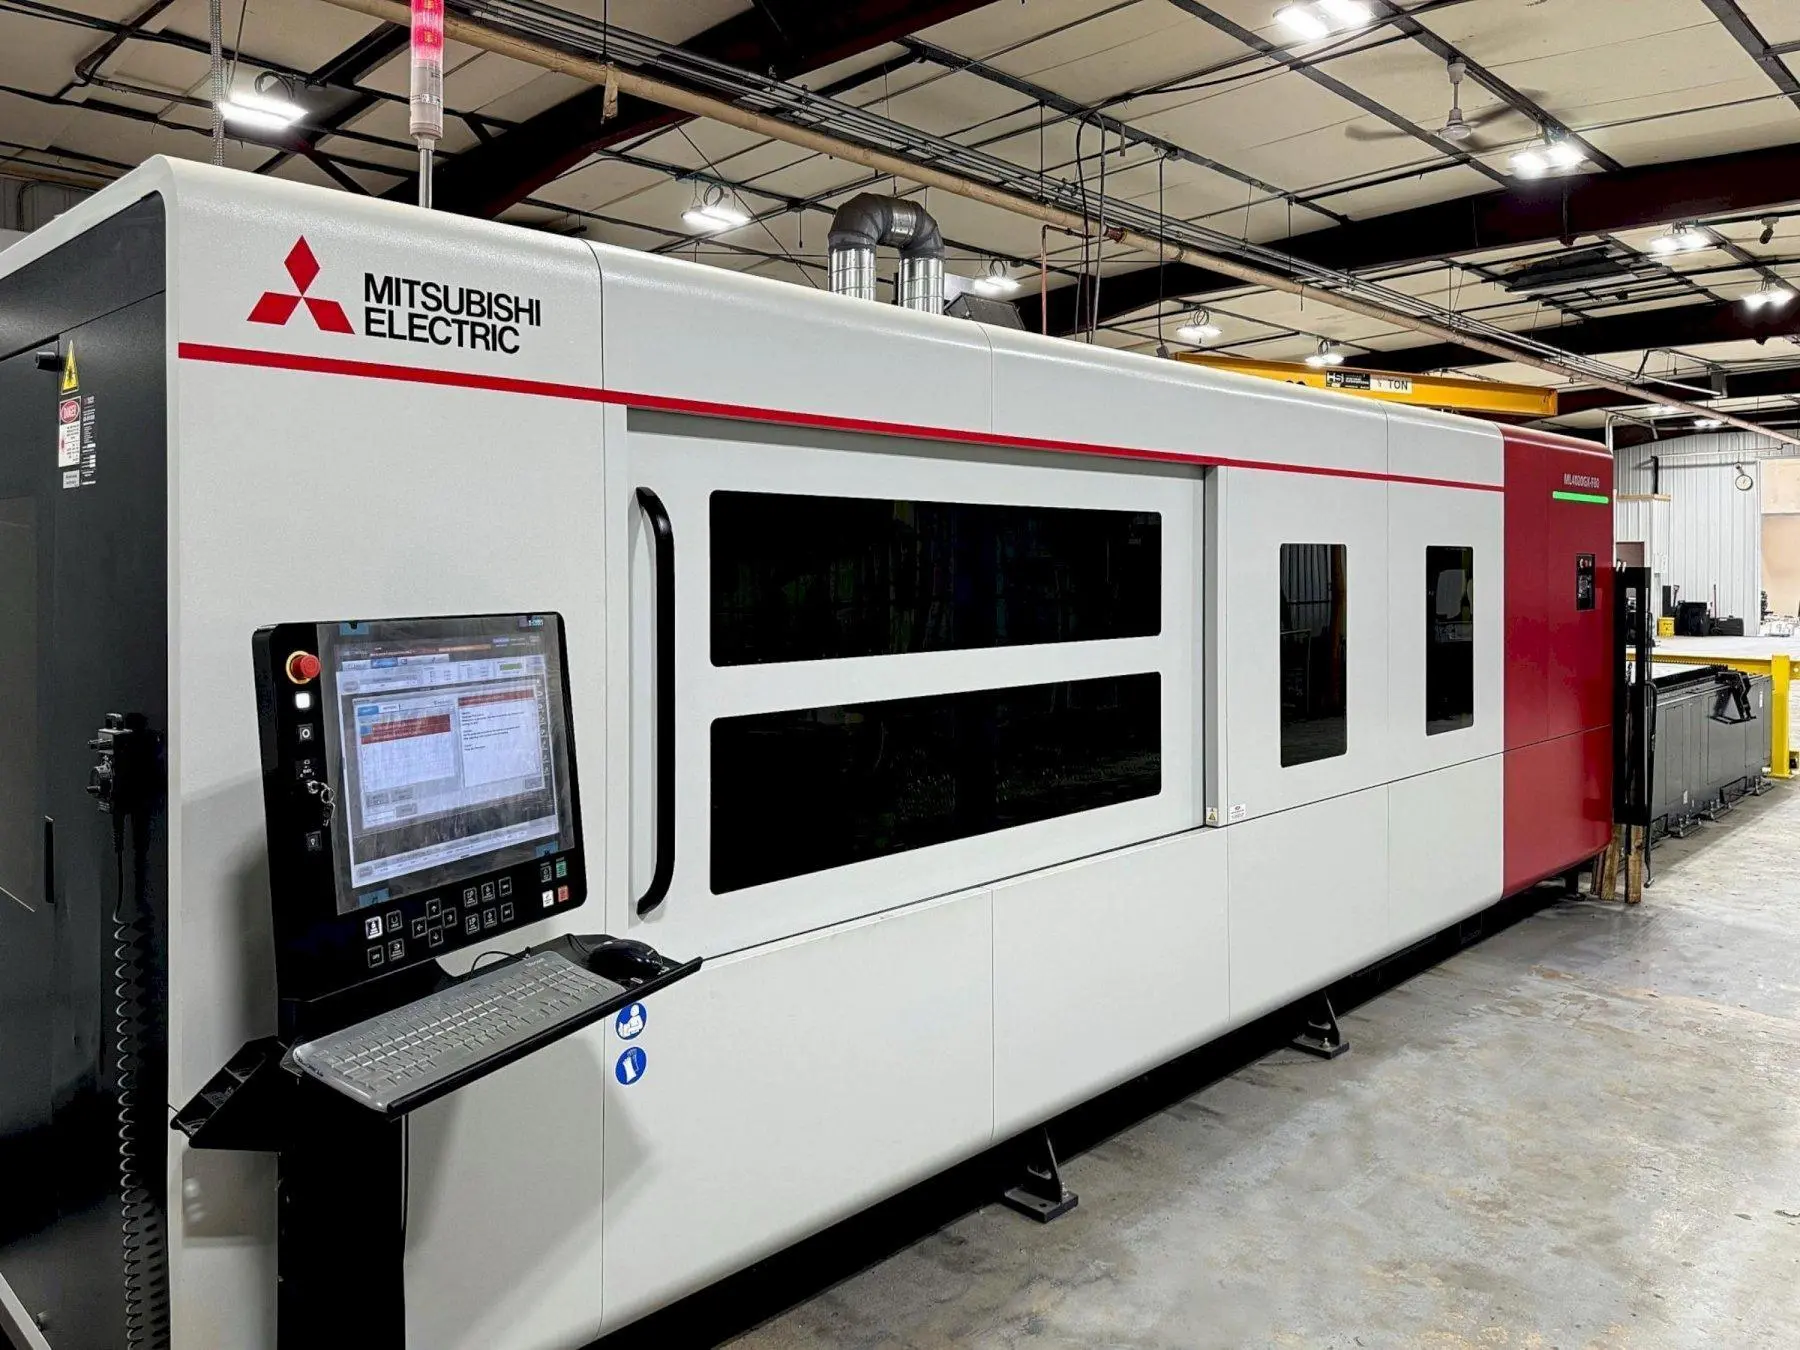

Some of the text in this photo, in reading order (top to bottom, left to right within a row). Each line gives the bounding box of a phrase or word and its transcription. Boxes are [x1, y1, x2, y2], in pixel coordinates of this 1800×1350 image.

[364, 272, 541, 327] MITSUBISHI
[364, 306, 520, 354] ELECTRIC
[1387, 379, 1408, 391] TON
